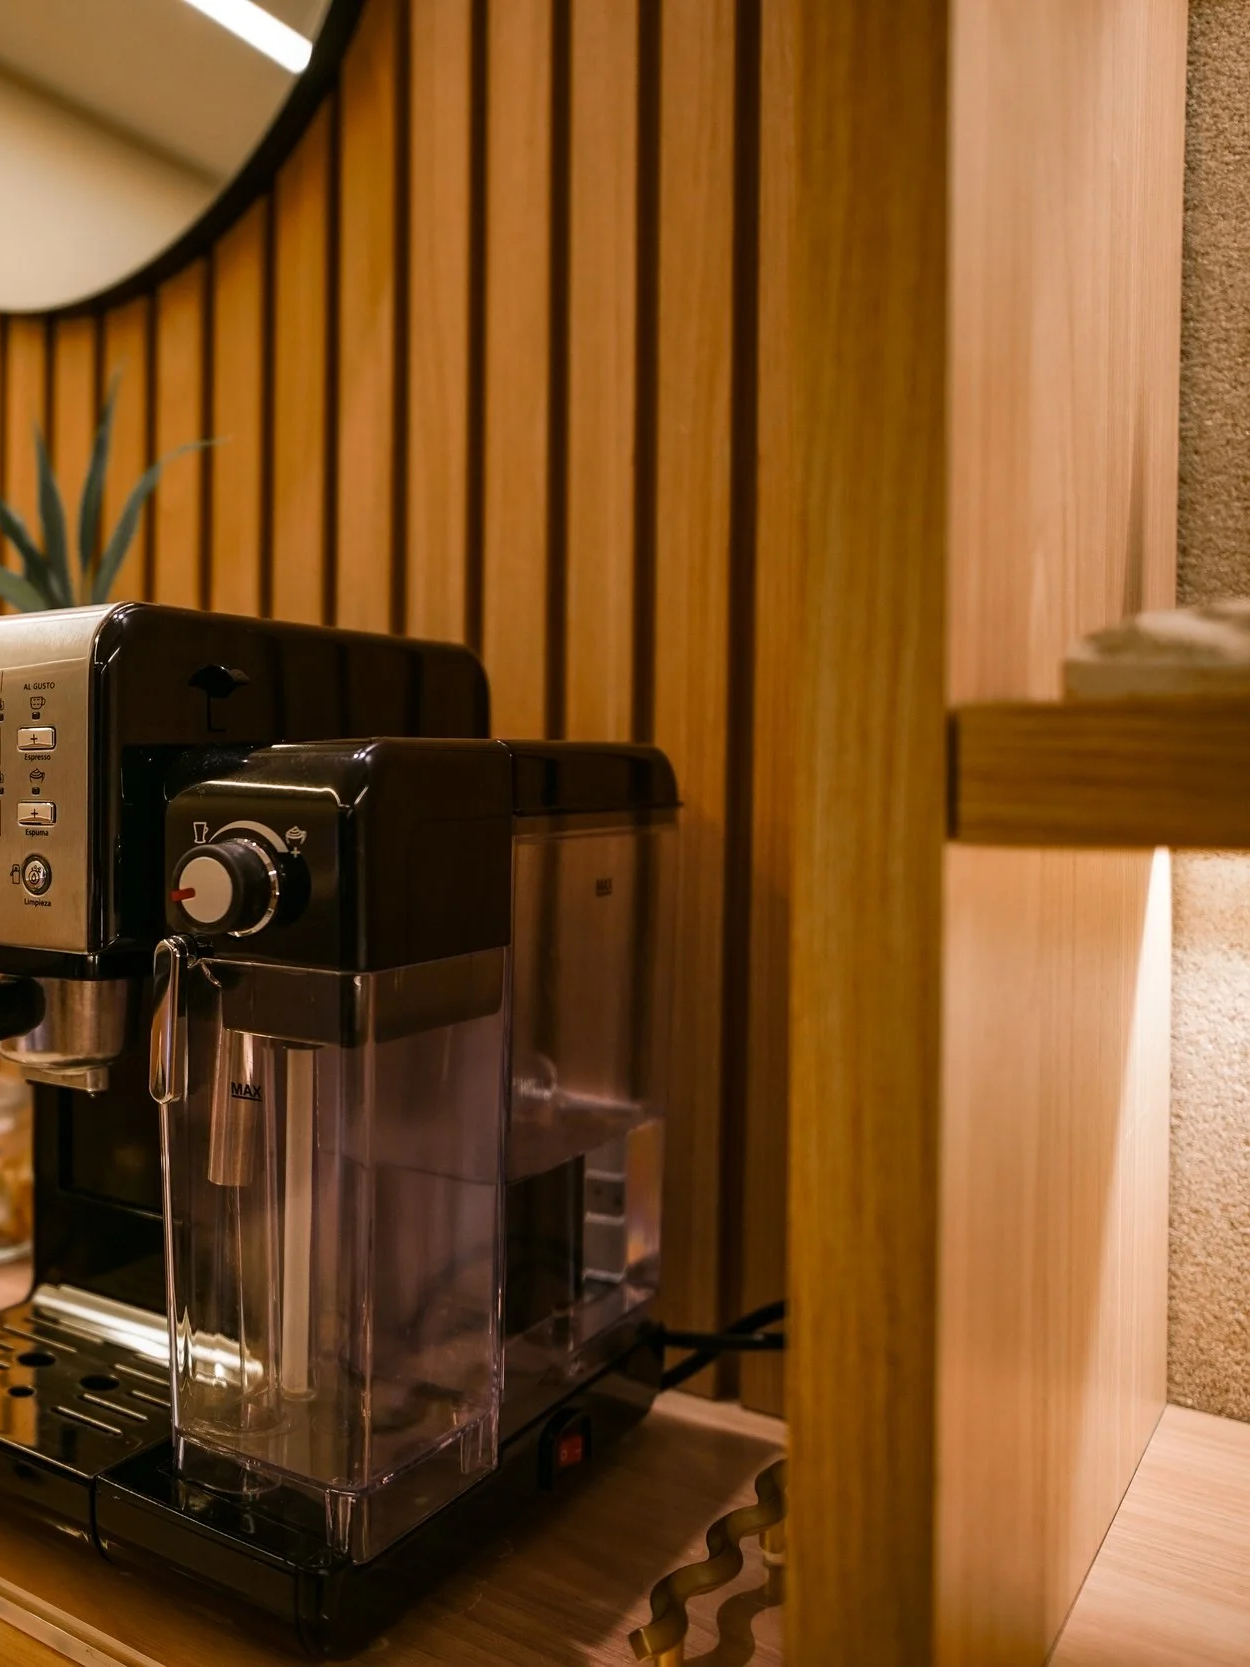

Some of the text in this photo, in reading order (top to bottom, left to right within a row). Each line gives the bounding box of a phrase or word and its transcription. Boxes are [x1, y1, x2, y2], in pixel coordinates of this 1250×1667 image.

[33, 682, 56, 690] GUSTO
[24, 753, 51, 762] Espresso
[25, 829, 49, 837] Espuma
[24, 898, 52, 907] Limpieza
[231, 1082, 262, 1099] MAX
